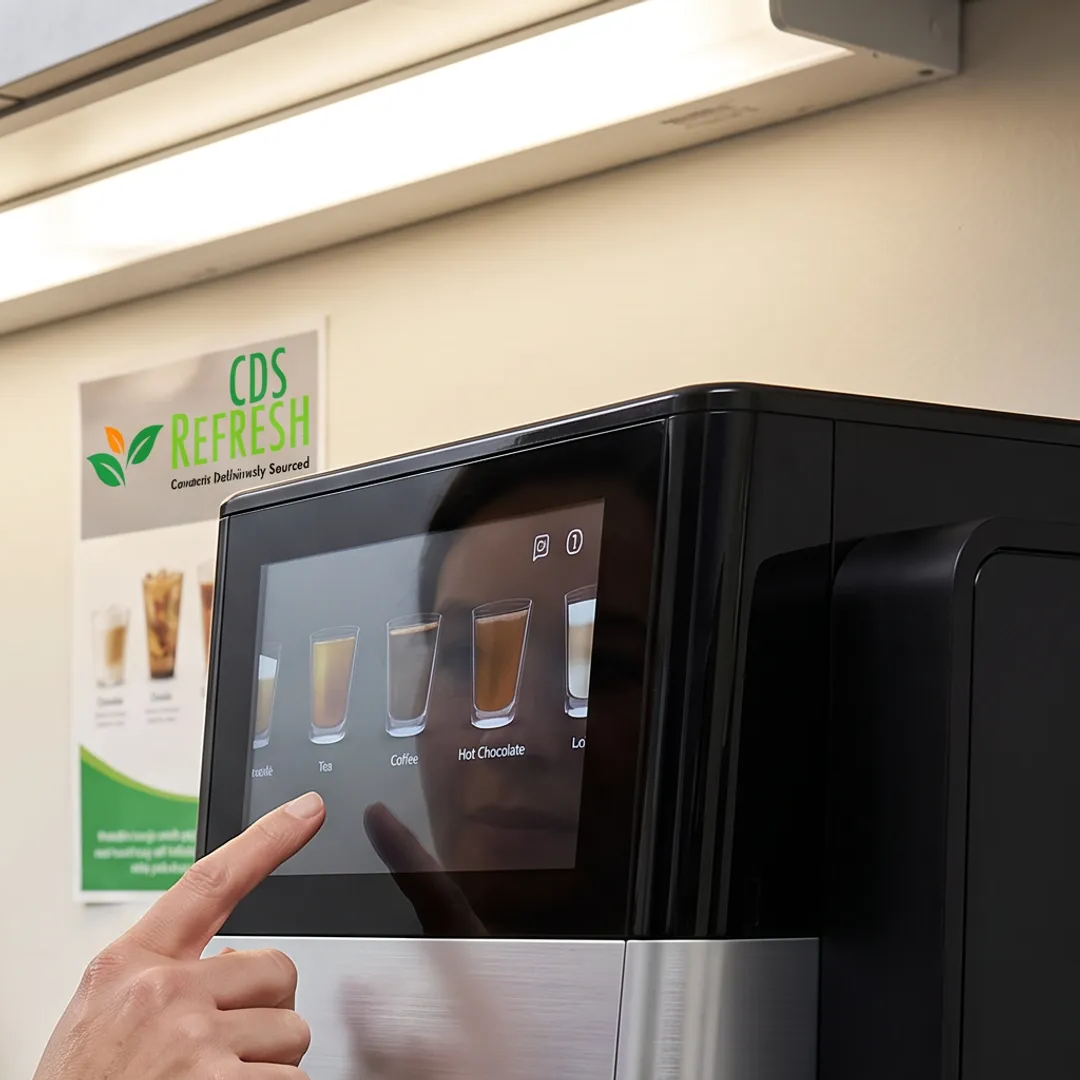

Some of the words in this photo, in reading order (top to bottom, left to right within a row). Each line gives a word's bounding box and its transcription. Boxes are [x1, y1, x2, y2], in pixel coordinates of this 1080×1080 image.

[229, 346, 287, 407] CDS
[170, 395, 310, 470] REFRESH
[572, 736, 587, 749] Lo
[390, 752, 419, 767] Coffee
[458, 746, 476, 761] Hot
[477, 743, 526, 760] Chocolate
